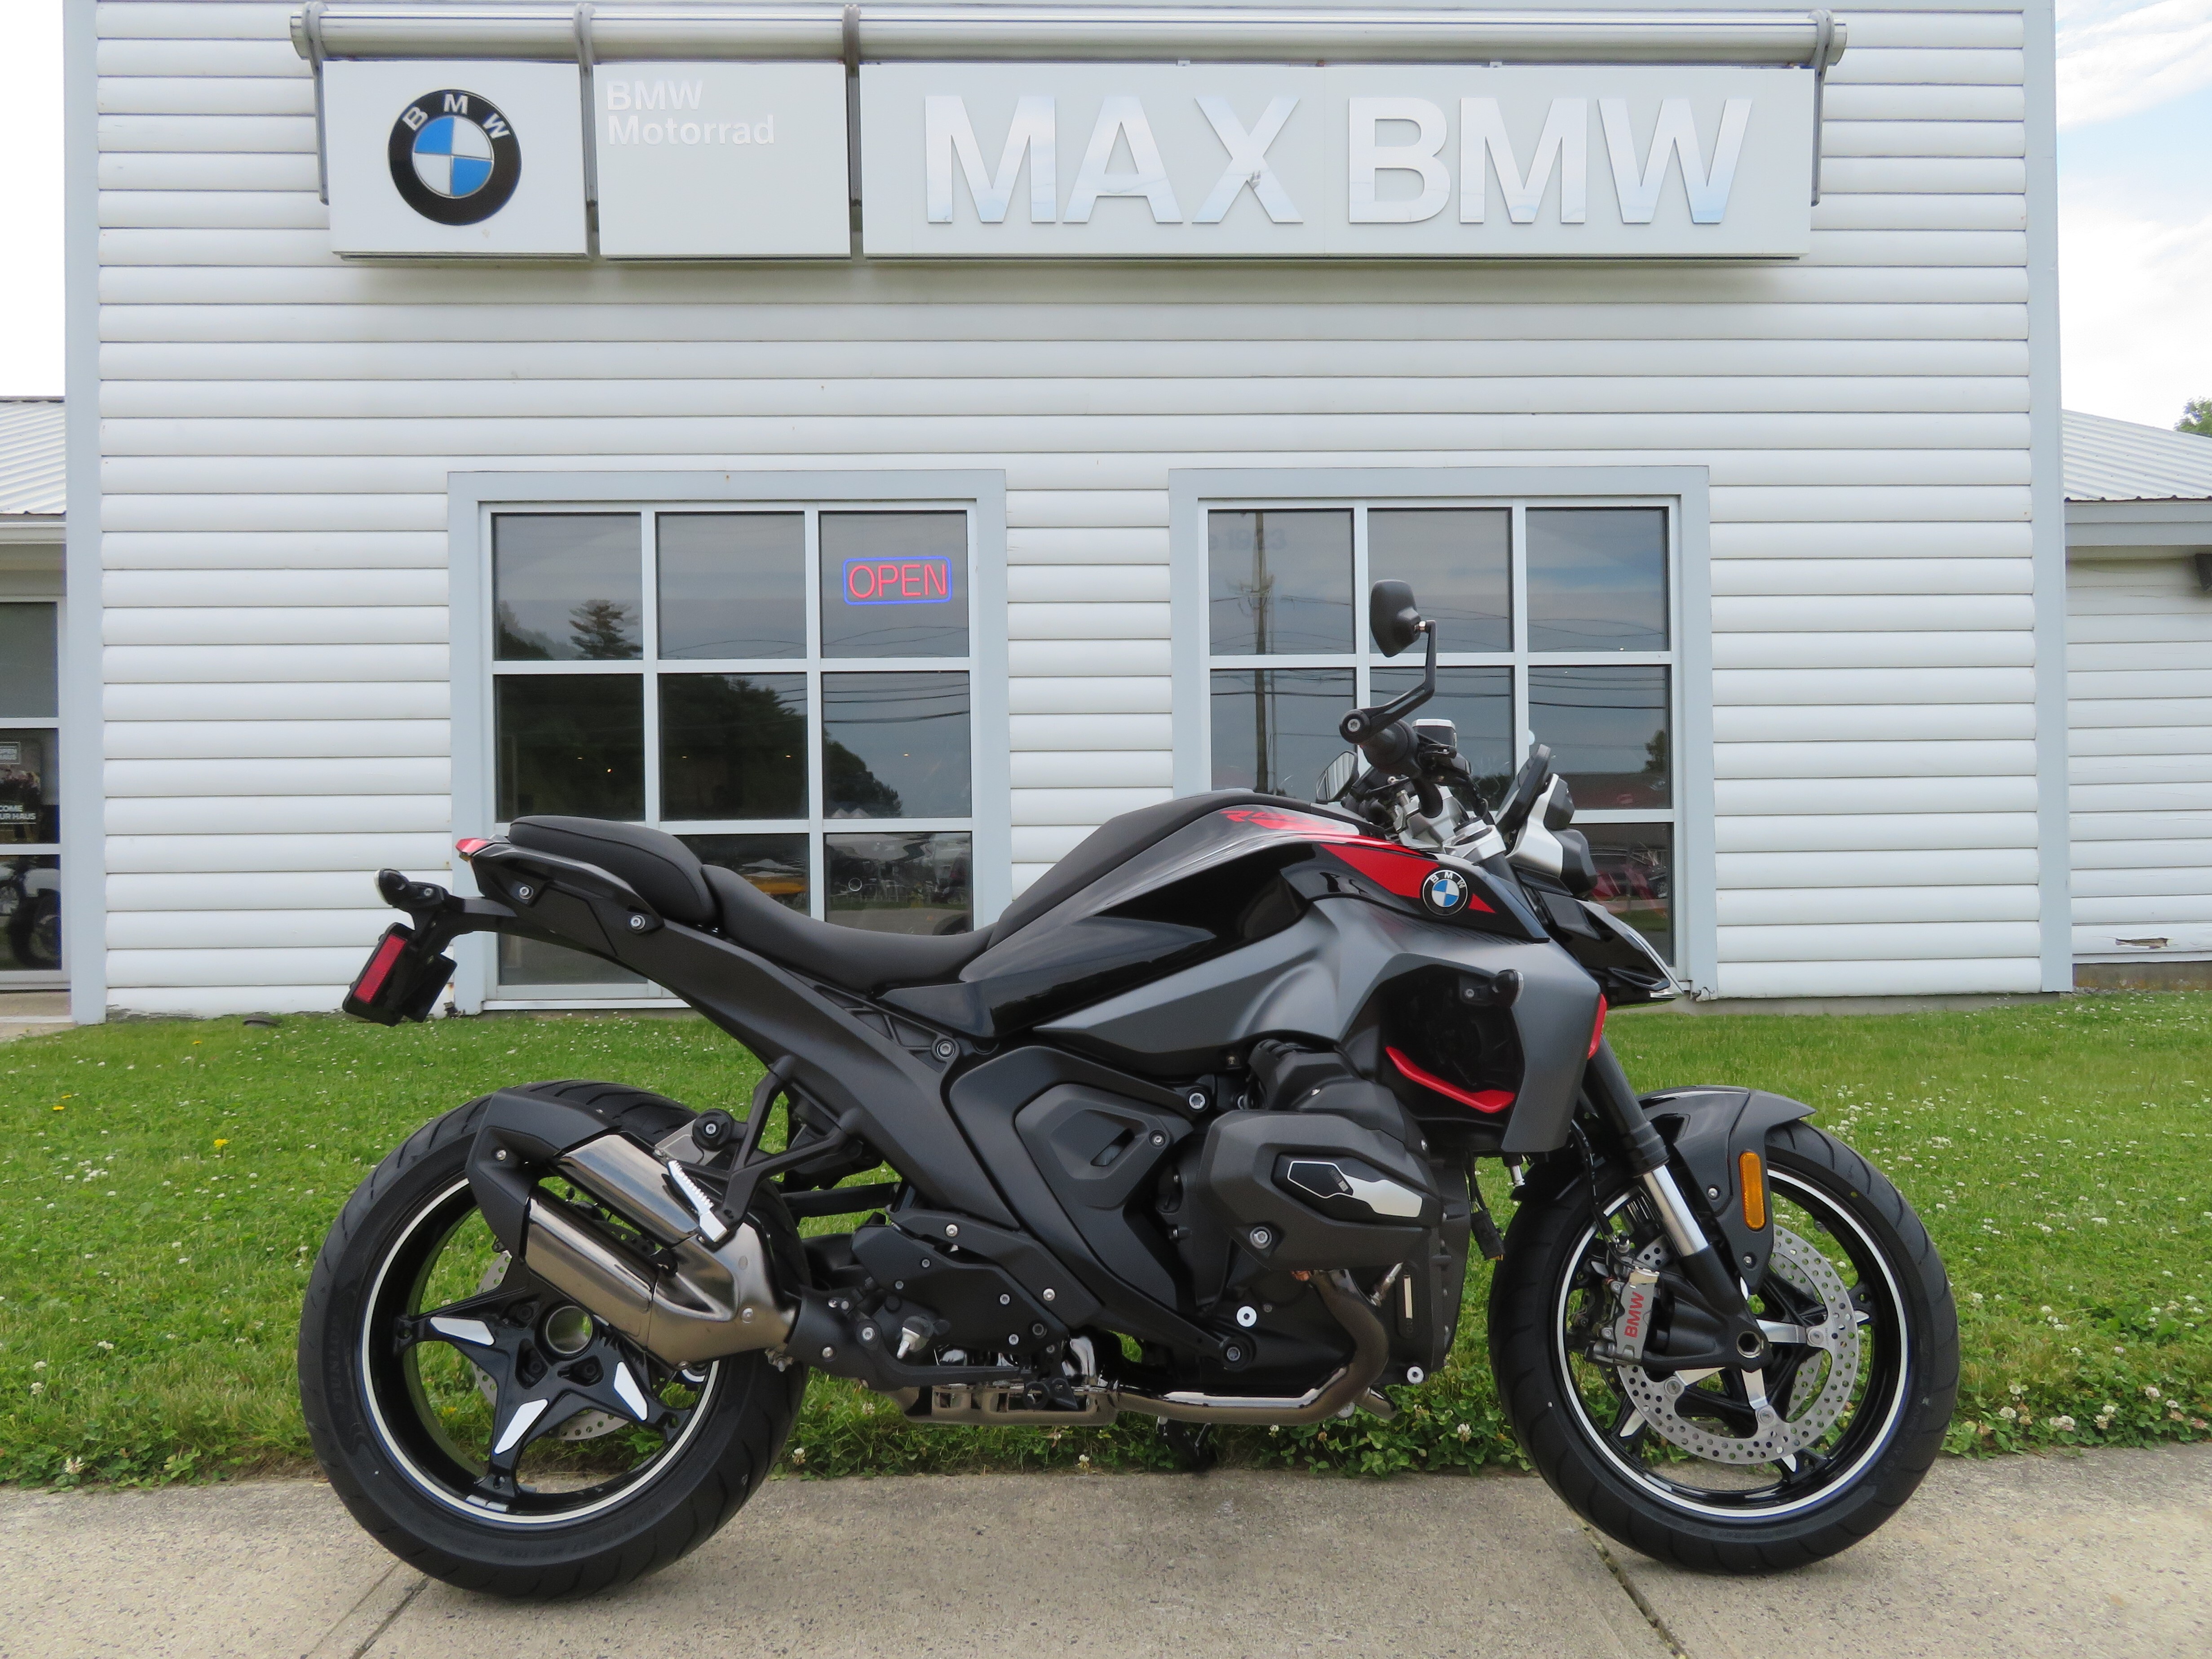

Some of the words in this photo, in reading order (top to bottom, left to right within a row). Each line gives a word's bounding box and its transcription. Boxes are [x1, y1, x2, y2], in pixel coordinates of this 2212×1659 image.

[605, 81, 703, 111] BMW
[402, 93, 510, 140] BMW
[607, 115, 775, 146] Motorrad
[924, 95, 1304, 224] MAX
[1348, 97, 1753, 224] BMW
[848, 564, 947, 599] OPEN
[1429, 872, 1466, 889] BMW
[1624, 1291, 1645, 1338] BMW
